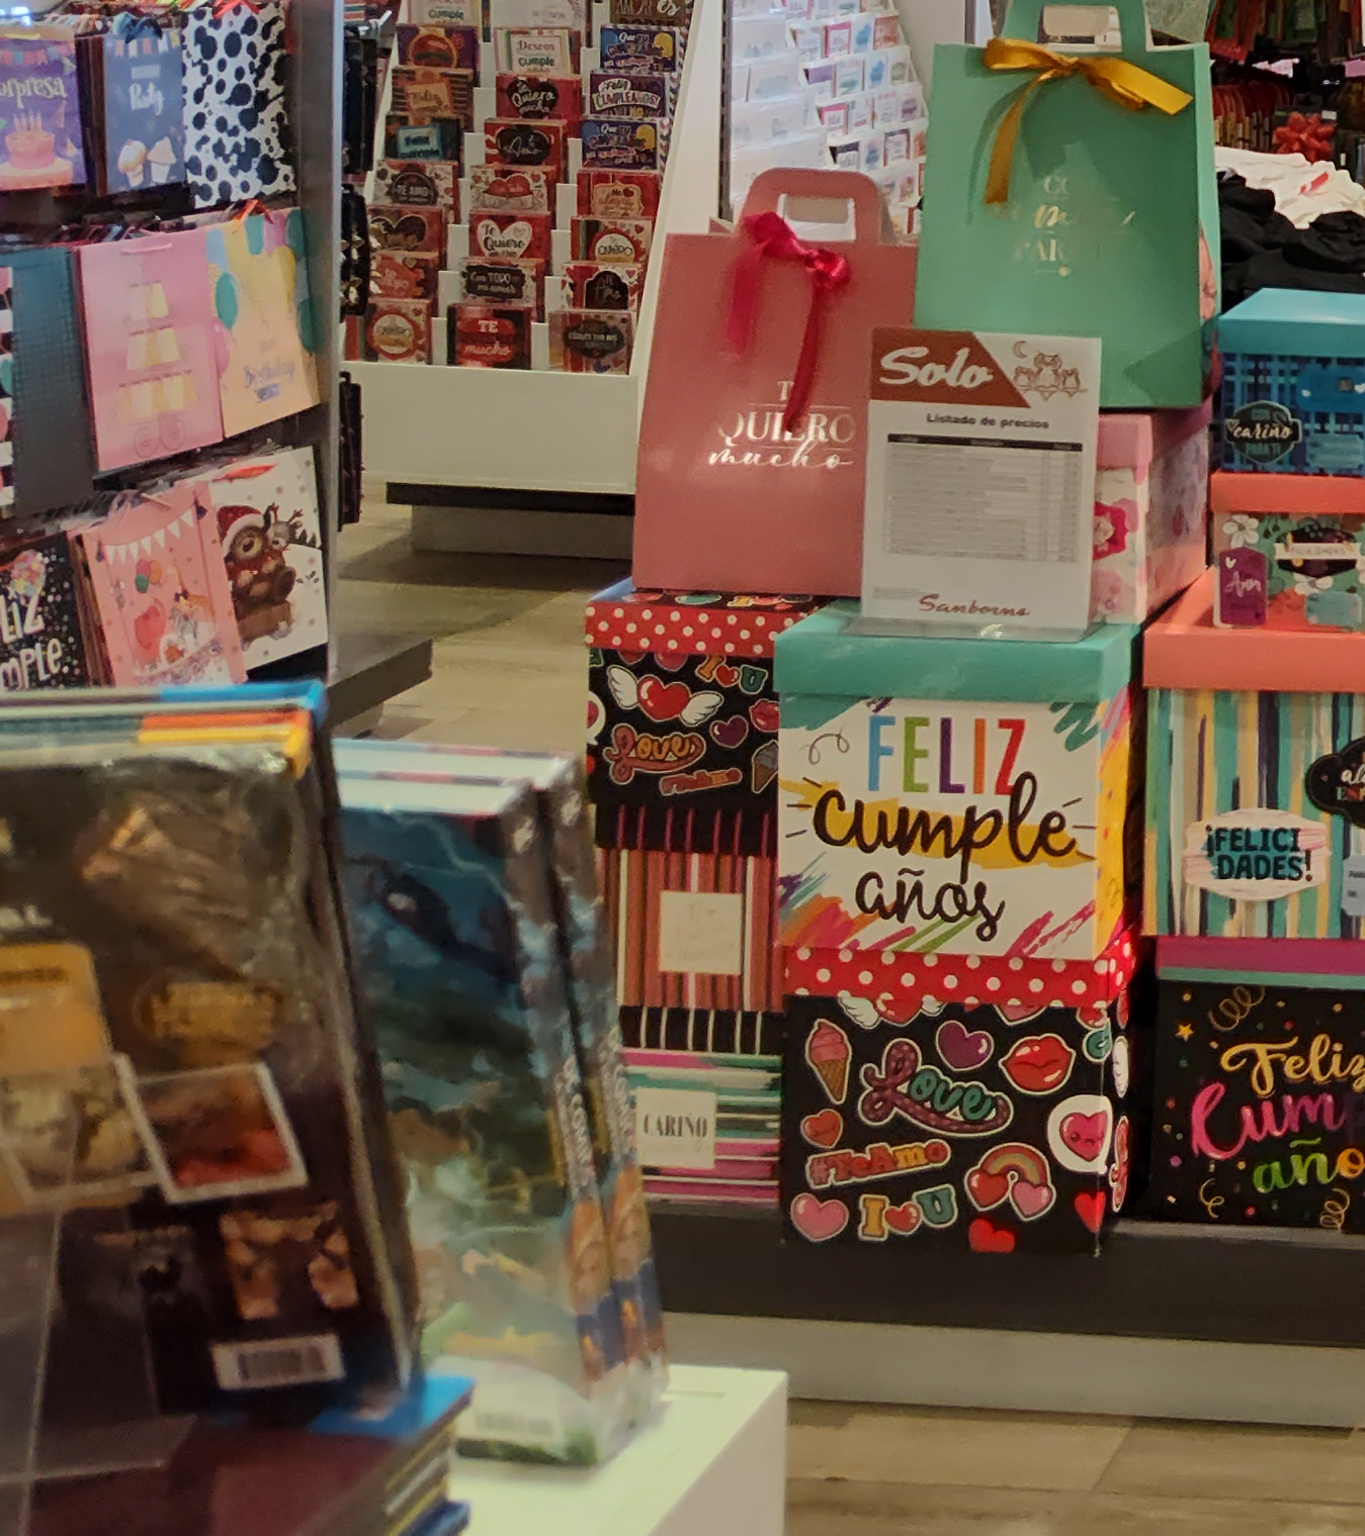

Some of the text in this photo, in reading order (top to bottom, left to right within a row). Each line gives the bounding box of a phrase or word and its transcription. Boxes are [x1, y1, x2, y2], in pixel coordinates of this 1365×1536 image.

[517, 39, 556, 53] Deseos
[0, 75, 67, 110] orpresa
[478, 320, 498, 333] TE
[878, 346, 994, 390] Solo
[926, 412, 976, 426] Listado
[980, 414, 996, 427] de
[1233, 421, 1294, 441] cariño
[708, 438, 855, 470] mucho
[0, 590, 45, 644] LIZ
[918, 592, 1031, 617] Sanborns
[739, 664, 769, 695] U
[866, 715, 1027, 796] FELIZ
[812, 771, 1078, 883] cumple
[1204, 824, 1302, 859] ¡FELICI
[1216, 848, 1313, 883] DADES!
[854, 867, 1006, 943] años
[860, 1038, 1014, 1135] Love
[643, 1111, 708, 1140] CARIÑO
[913, 1185, 958, 1227] U
